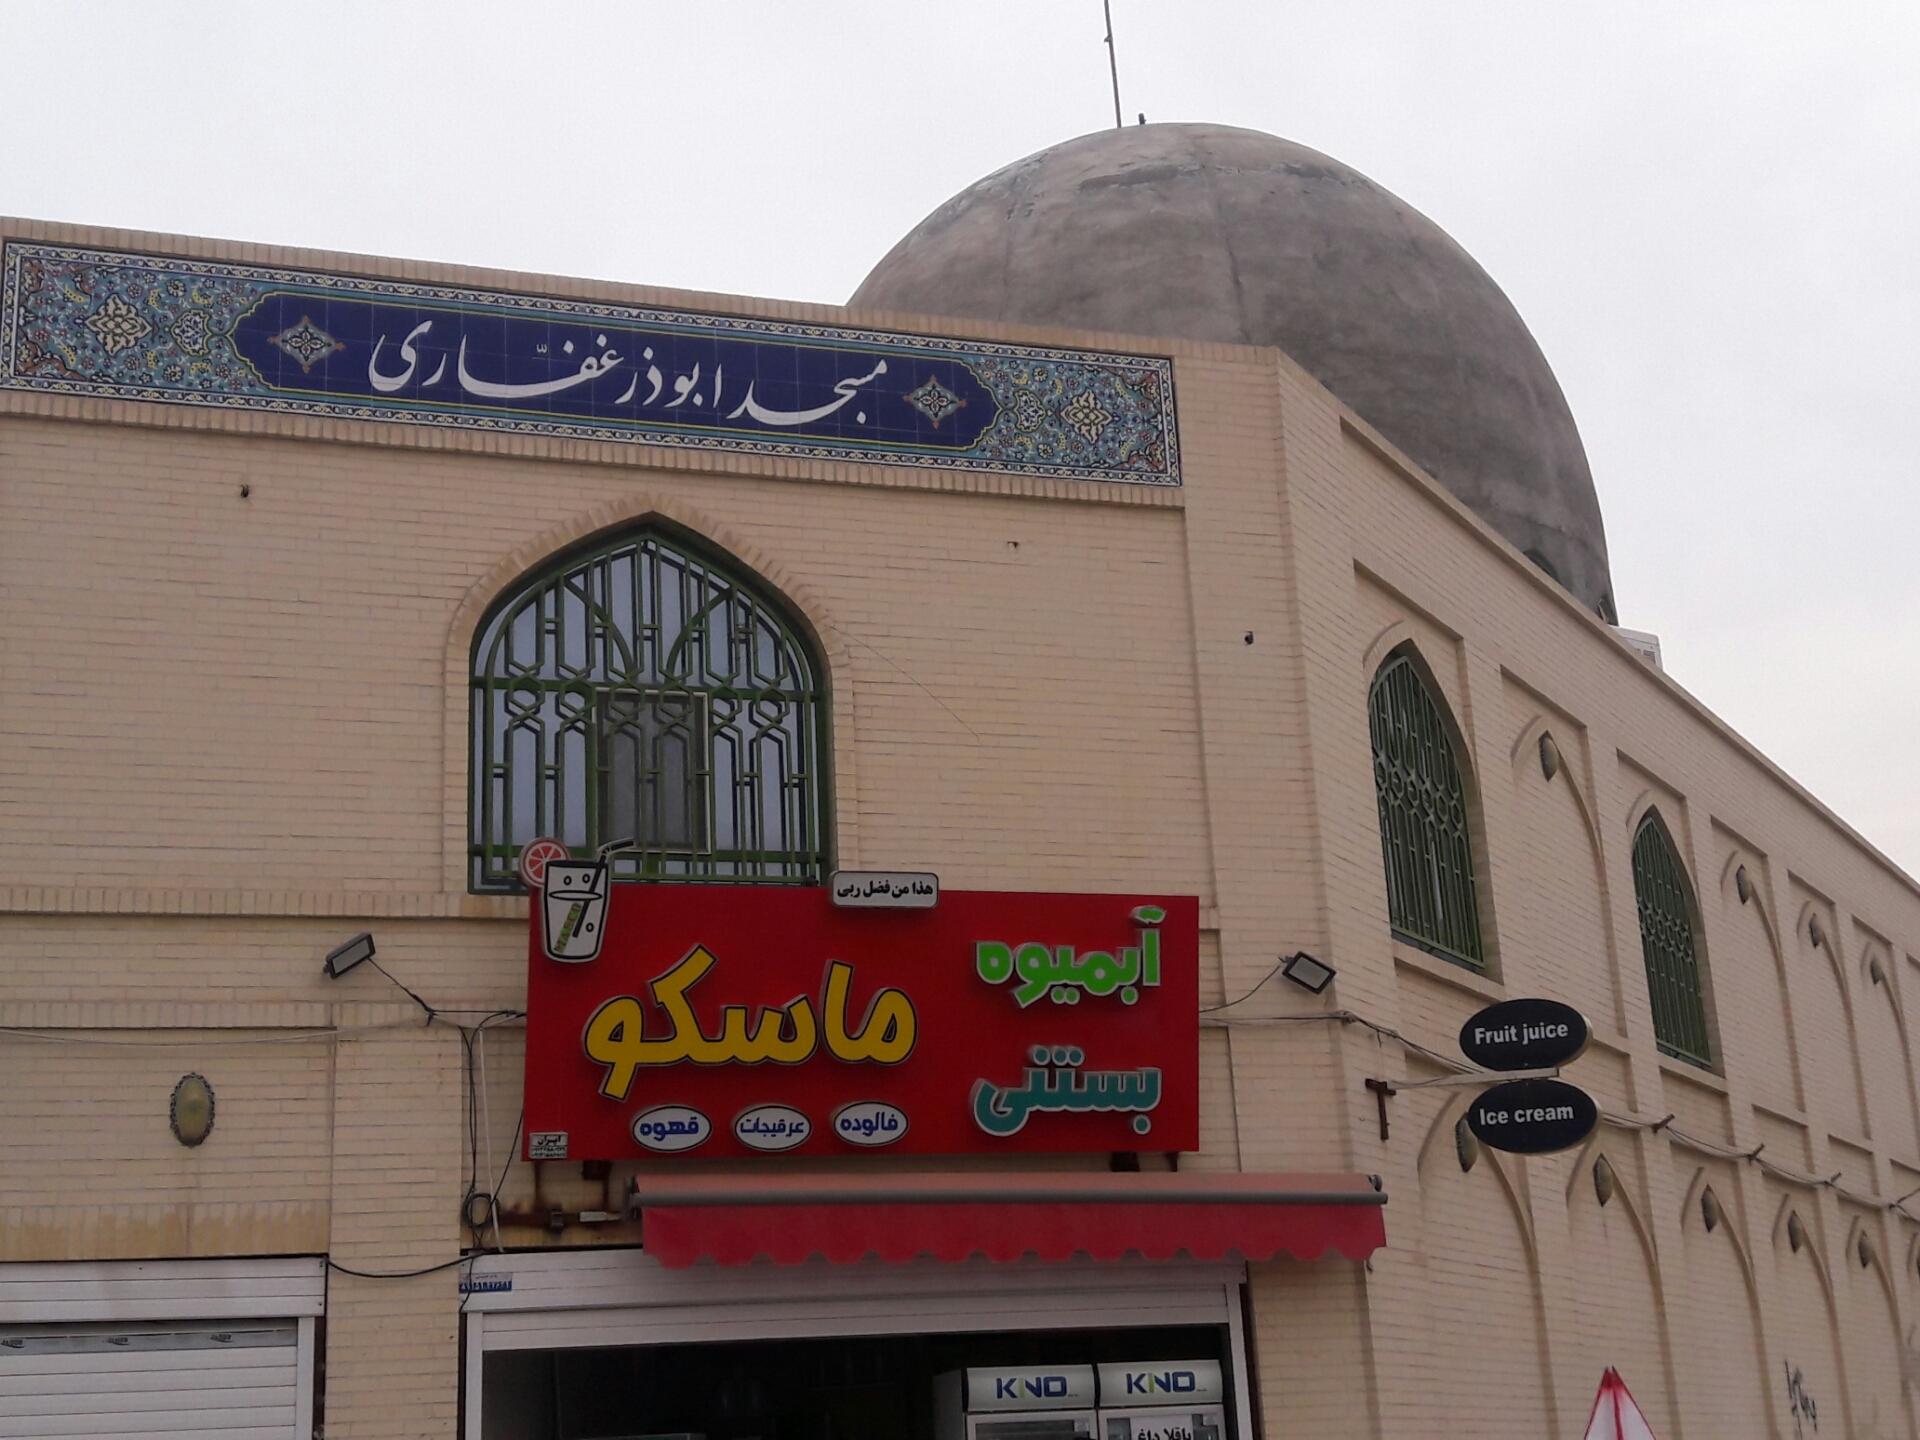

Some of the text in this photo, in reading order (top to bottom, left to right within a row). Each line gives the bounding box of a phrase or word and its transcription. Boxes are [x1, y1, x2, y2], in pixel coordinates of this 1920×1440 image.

[724, 359, 889, 425] مسجد
[863, 880, 891, 898] فضل
[891, 885, 910, 899] من
[912, 880, 934, 896] هذا
[976, 906, 1167, 1008] آبمیوه
[583, 944, 918, 1102] ماسکو
[1474, 1022, 1569, 1045] Fruit juice
[973, 1046, 1162, 1137] بستنی
[740, 1117, 804, 1137] عرقیجات
[840, 1111, 898, 1137] فالوده
[1479, 1105, 1574, 1126] Ice cream
[640, 1116, 699, 1142] قهوه
